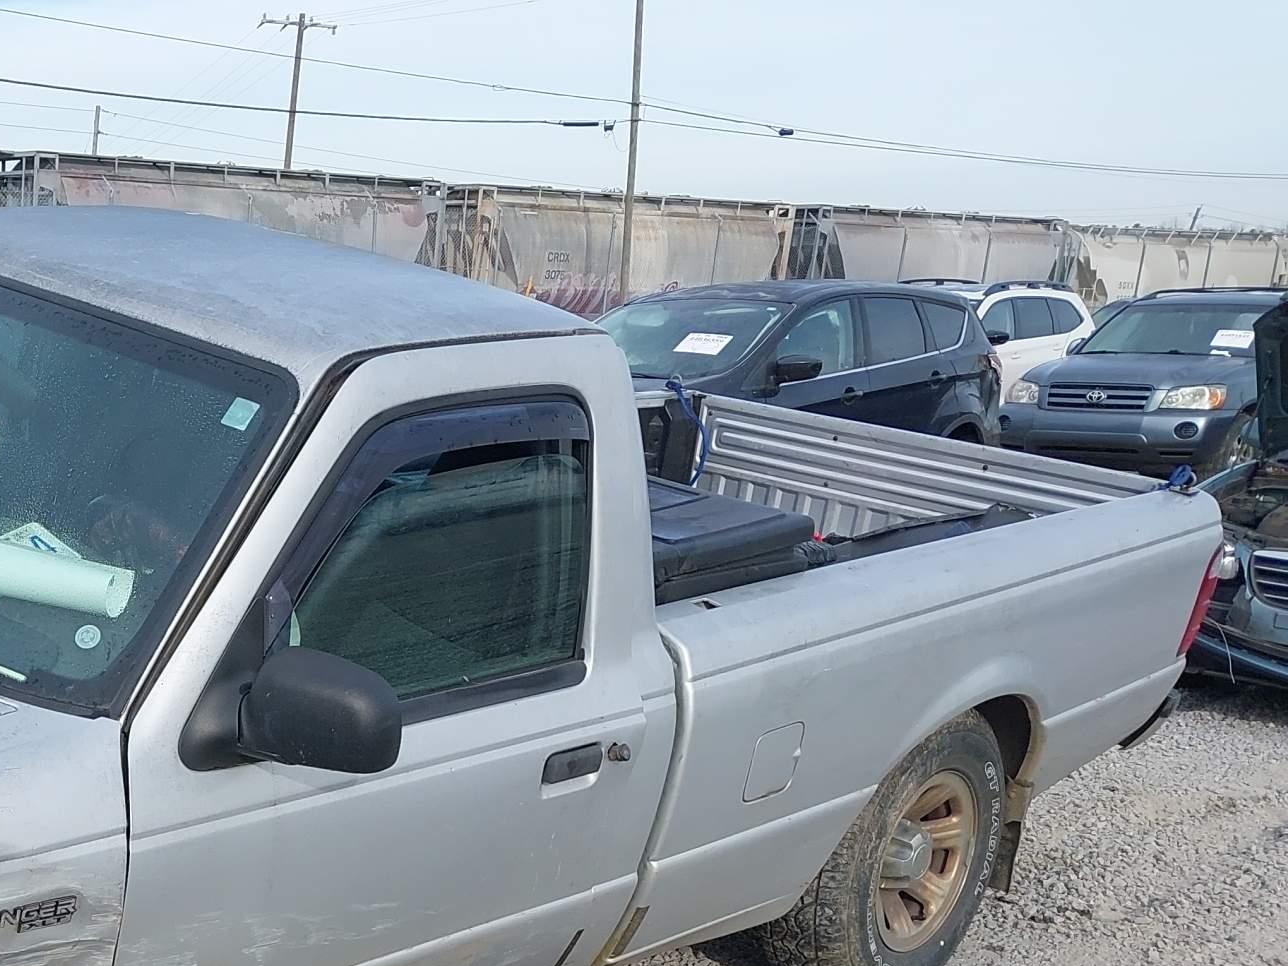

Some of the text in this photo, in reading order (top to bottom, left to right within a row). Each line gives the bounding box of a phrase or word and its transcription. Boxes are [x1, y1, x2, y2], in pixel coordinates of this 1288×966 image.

[547, 252, 570, 263] CRDX
[975, 797, 1000, 896] RADIAL
[19, 914, 73, 931] XLT
